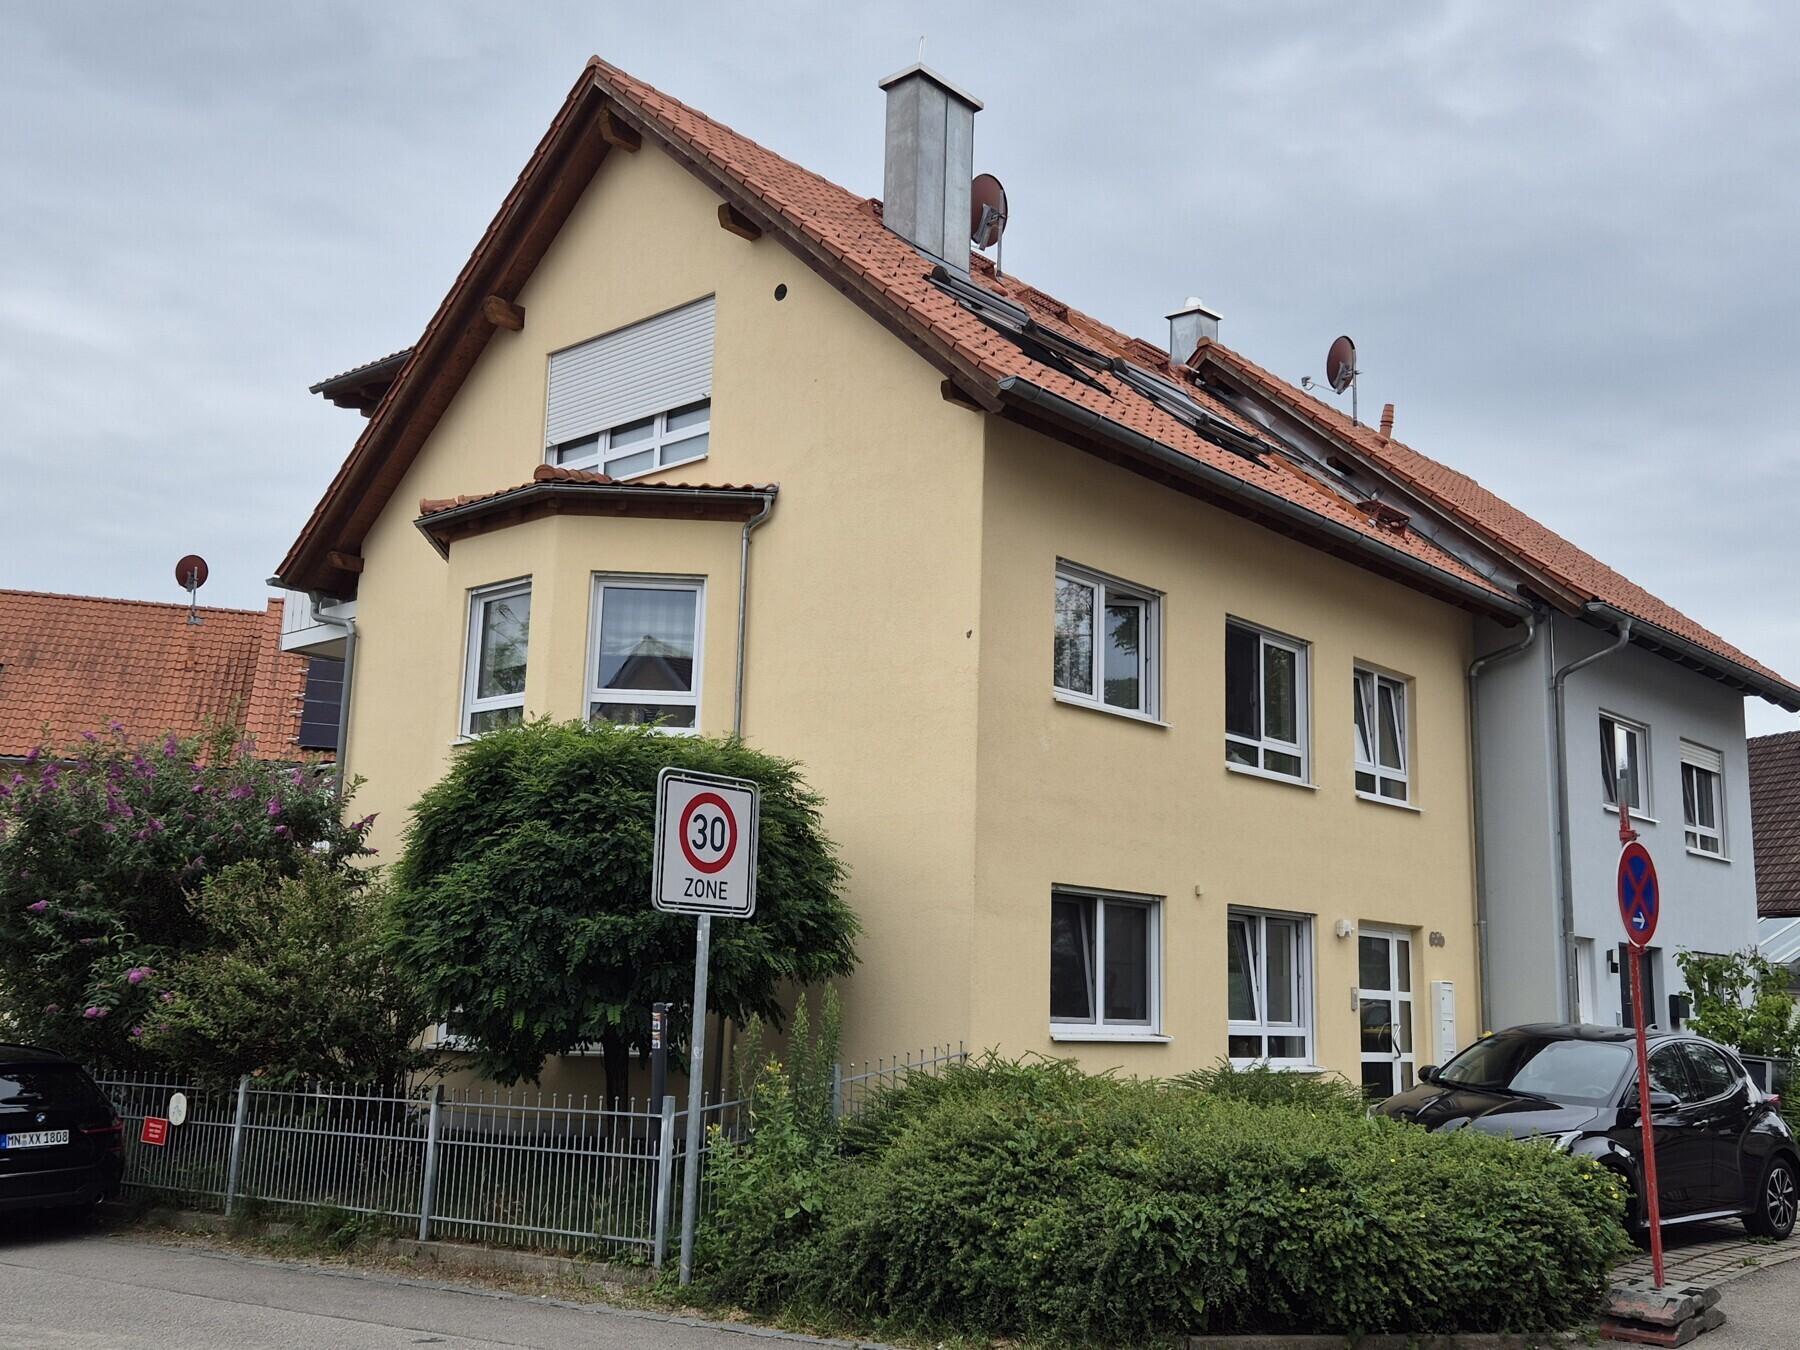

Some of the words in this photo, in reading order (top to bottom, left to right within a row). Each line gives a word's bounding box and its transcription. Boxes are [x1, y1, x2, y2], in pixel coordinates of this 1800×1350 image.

[692, 814, 725, 852] 30
[684, 878, 728, 900] ZONE
[7, 1134, 21, 1147] MN
[29, 1133, 41, 1145] XX
[44, 1131, 68, 1143] 1808
